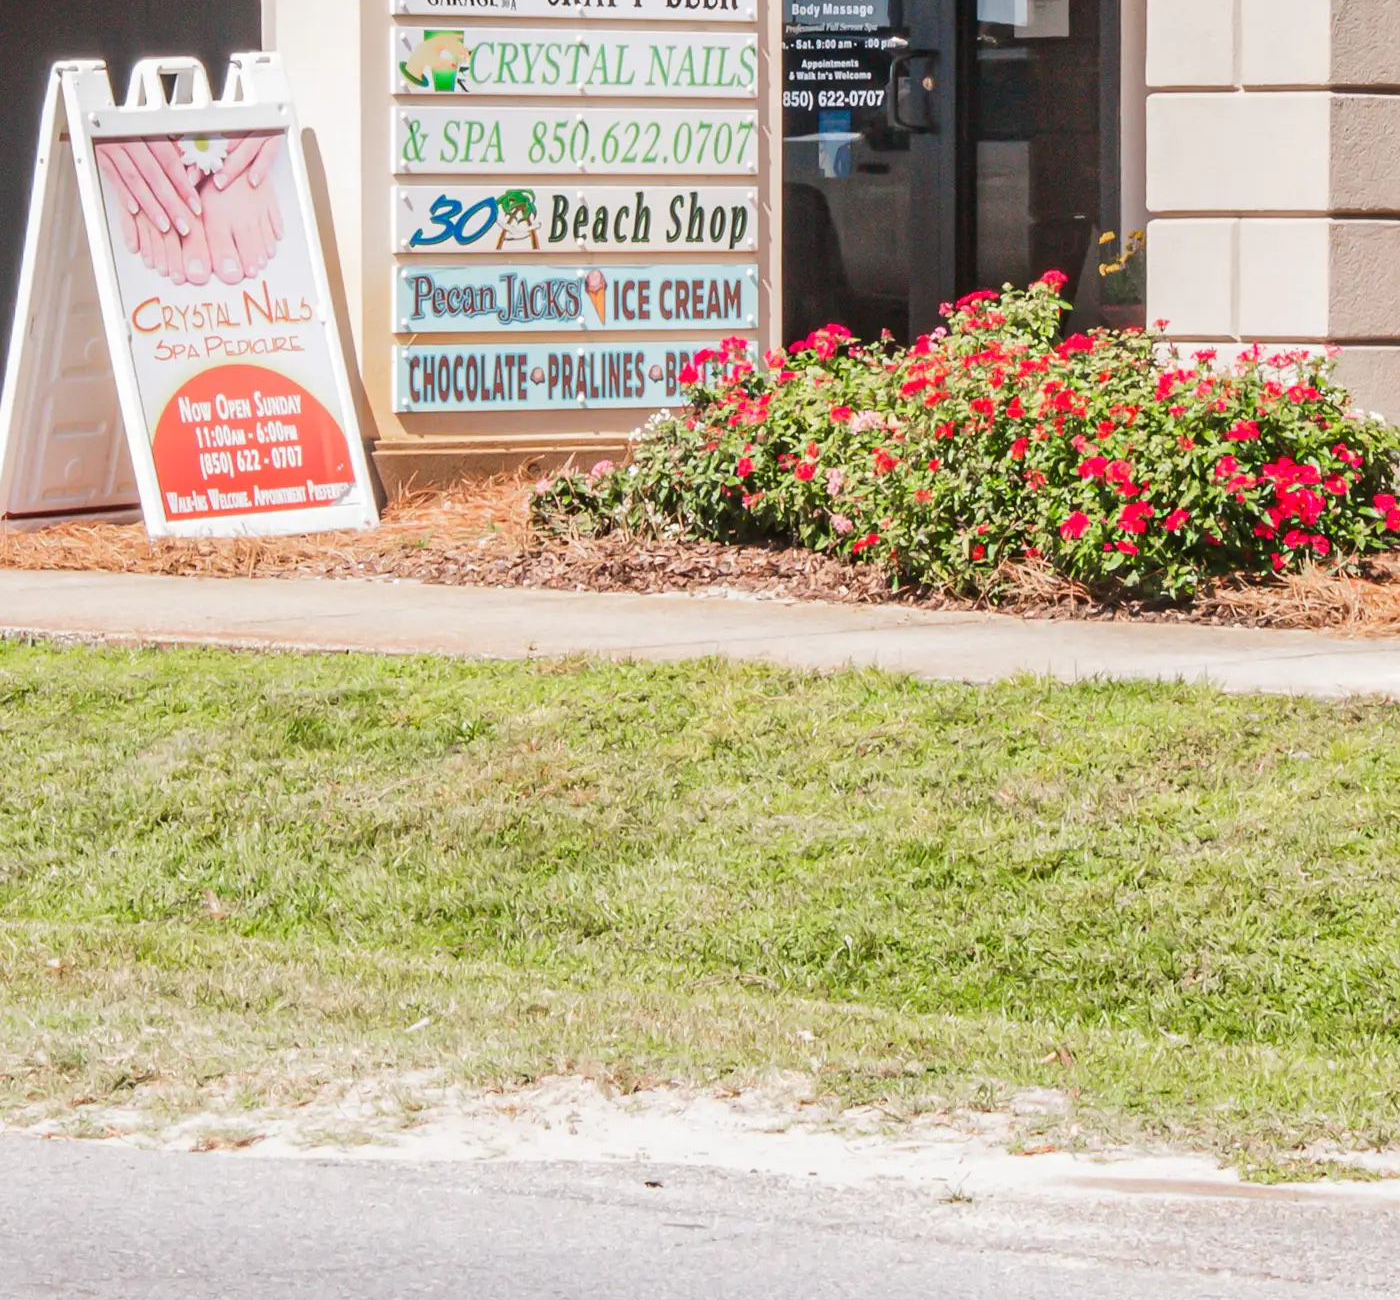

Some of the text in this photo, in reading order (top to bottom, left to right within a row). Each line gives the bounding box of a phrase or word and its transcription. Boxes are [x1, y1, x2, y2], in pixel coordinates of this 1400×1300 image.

[791, 3, 874, 18] Body Massage
[796, 39, 814, 50] Sat.
[816, 38, 836, 50] 9:00
[838, 39, 852, 50] am
[469, 41, 757, 88] CRYSTAL NAILS
[788, 71, 795, 81] &
[796, 71, 816, 81] Walk
[834, 70, 872, 81] Welcome
[801, 58, 859, 70] Appointments
[782, 90, 885, 111] 850) 622-0707
[402, 119, 752, 165] & SPA 850.622.0707
[548, 191, 651, 243] Beach
[665, 191, 749, 250] Shop
[132, 280, 313, 333] CRYSTAL NAILS
[410, 273, 498, 319] Pecan
[613, 279, 650, 321] ICE
[659, 279, 742, 320] CREAM
[154, 335, 306, 361] SPA PEDICURE
[409, 352, 528, 402] CHOCOLATE
[547, 350, 646, 400] PRALINES
[178, 391, 302, 423] NOW OPEN SUNDAY
[195, 425, 246, 449] 11:00AM
[256, 420, 298, 444] 6:00PM
[199, 450, 235, 480] (850)
[237, 449, 262, 473] 622
[271, 445, 303, 469] 0707
[253, 485, 307, 507] APPOINTMENT
